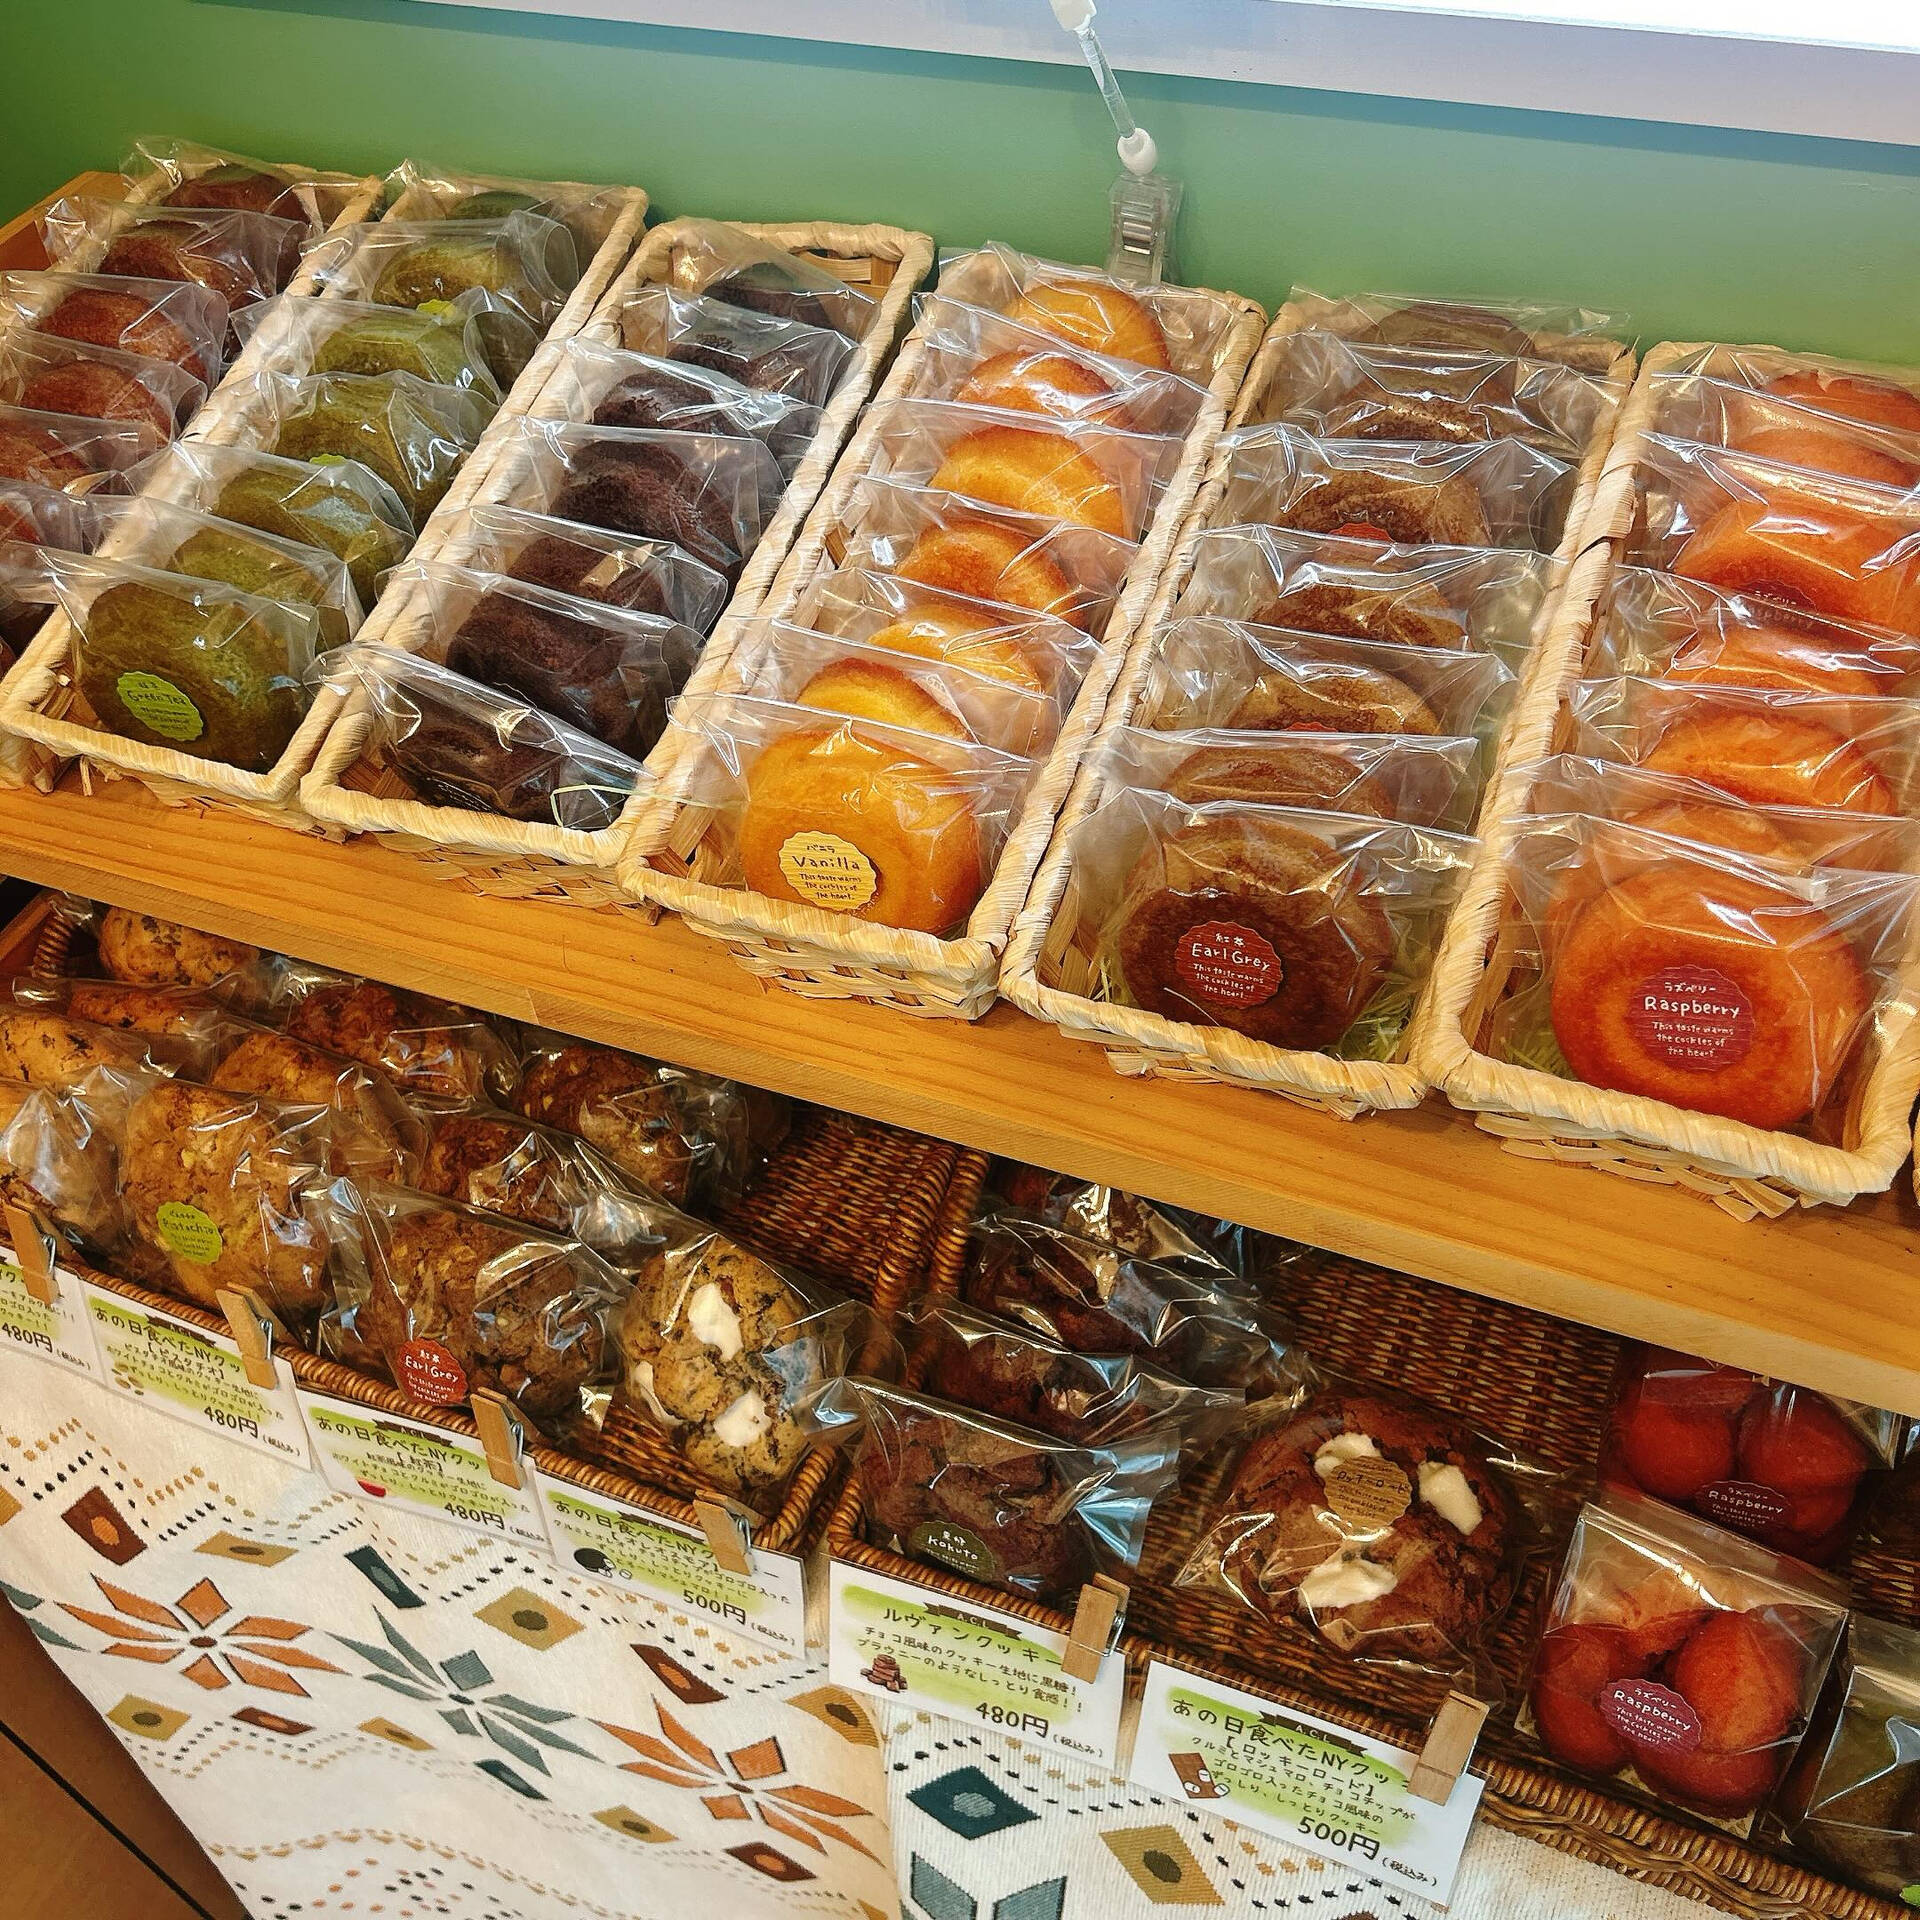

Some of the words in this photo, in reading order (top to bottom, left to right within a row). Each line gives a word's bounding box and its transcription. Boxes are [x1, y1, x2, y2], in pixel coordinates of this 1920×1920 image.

[791, 855, 861, 871] Vanilla
[1215, 932, 1245, 947] 紅茶
[1191, 943, 1227, 960] Earl
[1231, 950, 1271, 972] Grey
[1663, 981, 1717, 994] ラズベリー
[1644, 996, 1740, 1019] Raspberry
[1651, 1021, 1673, 1031] This
[1676, 1023, 1701, 1033] taste
[1703, 1026, 1734, 1036] warms
[1656, 1033, 1673, 1043] the
[1714, 1037, 1726, 1048] of
[2, 1322, 53, 1353] 480円
[405, 1355, 428, 1374] Earl
[430, 1366, 459, 1383] Grey
[202, 1403, 259, 1438] 480円
[442, 1500, 504, 1530] 480円
[1708, 1489, 1784, 1514] Raspberry
[927, 1535, 979, 1560] Kokuto
[682, 1588, 746, 1625] 500円
[883, 1607, 1061, 1665] ルヴァンクッキー
[1613, 1689, 1692, 1731] Raspberry
[1634, 1687, 1677, 1709] ラズベリー
[975, 1700, 1048, 1739] 480円
[1191, 1734, 1416, 1822] クルミとマシュマロ、チョコチップが
[1225, 1734, 1374, 1797] 【ロッキーロード】
[1213, 1755, 1383, 1825] ゴロゴロ入ったチョコ風味の
[1297, 1814, 1380, 1862] 500円
